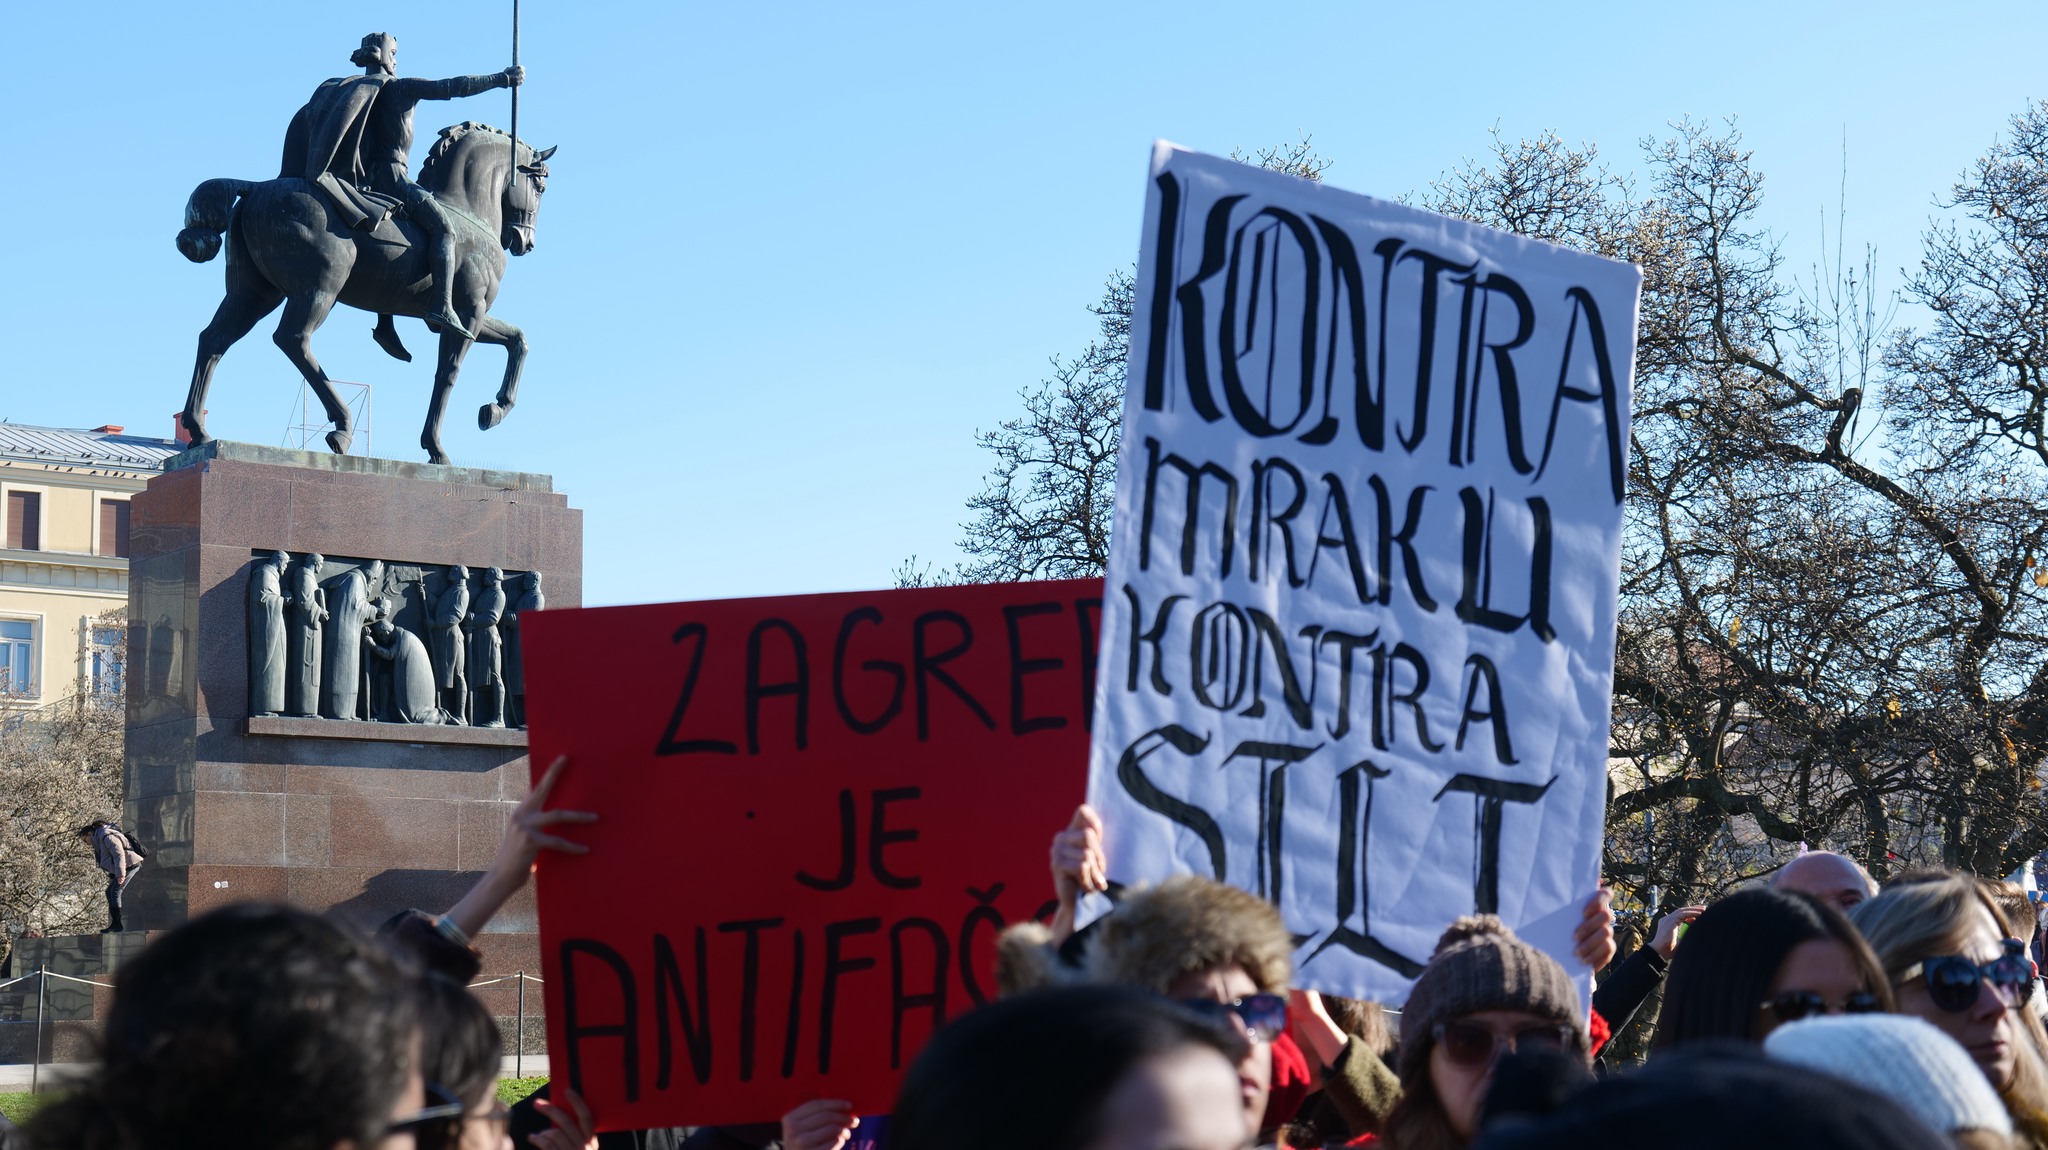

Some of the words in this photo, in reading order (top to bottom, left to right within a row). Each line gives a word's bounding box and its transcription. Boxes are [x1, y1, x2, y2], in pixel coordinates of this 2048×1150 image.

[1143, 171, 1626, 506] KONTRA
[1122, 583, 1520, 765] KONTRA
[795, 786, 922, 892] JE
